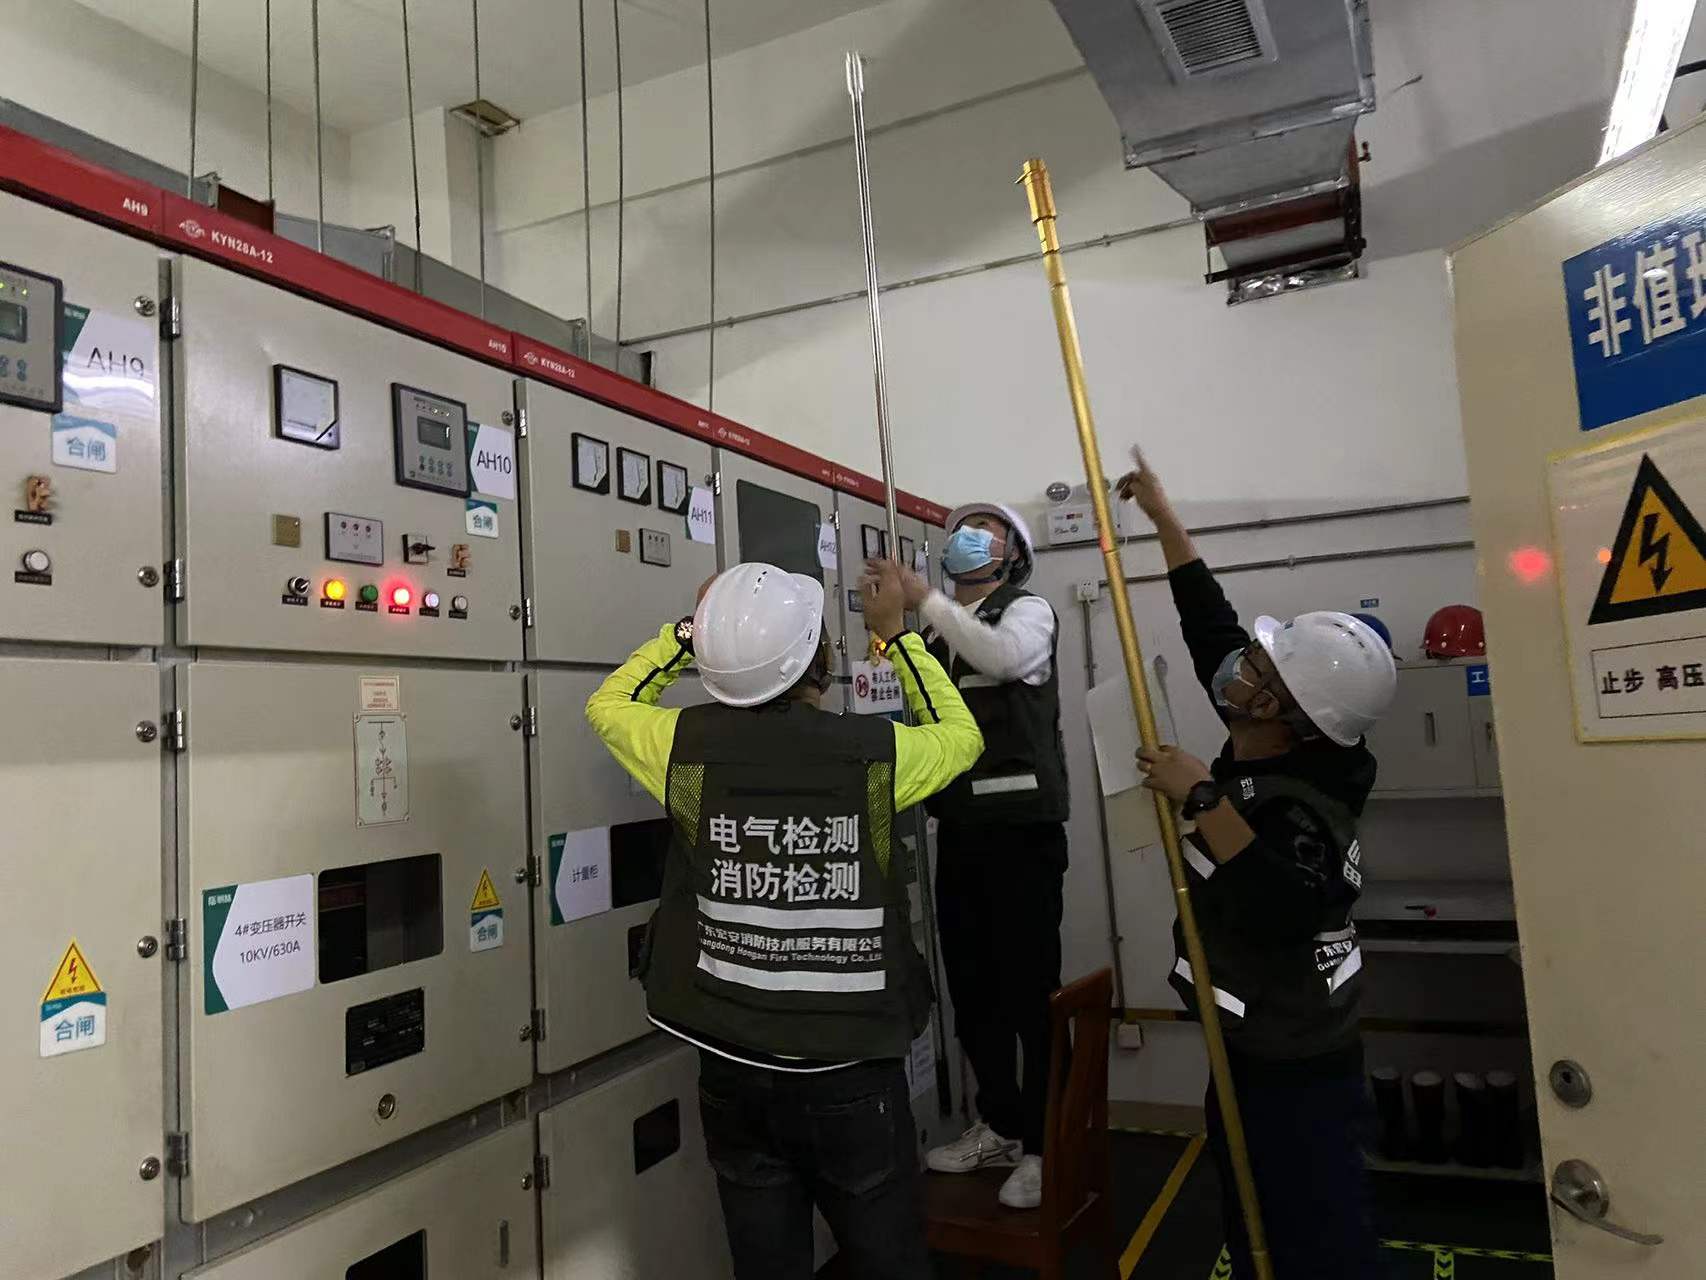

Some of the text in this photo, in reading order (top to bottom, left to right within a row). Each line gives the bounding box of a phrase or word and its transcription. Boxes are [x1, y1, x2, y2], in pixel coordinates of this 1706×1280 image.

[123, 197, 149, 216] AH9
[211, 230, 274, 264] KYN28A-12
[488, 339, 507, 354] AH10
[87, 347, 145, 377] AH9
[66, 436, 107, 462] 合闸
[476, 449, 512, 475] AH10
[1601, 663, 1706, 695] 止步 高压
[709, 813, 860, 855] 电气检测
[711, 859, 861, 902] 消防检测
[235, 911, 307, 937] 4#变压器开关
[240, 940, 301, 964] 10KV/630A
[791, 952, 848, 965] Technology
[55, 1015, 95, 1042] 合闸
